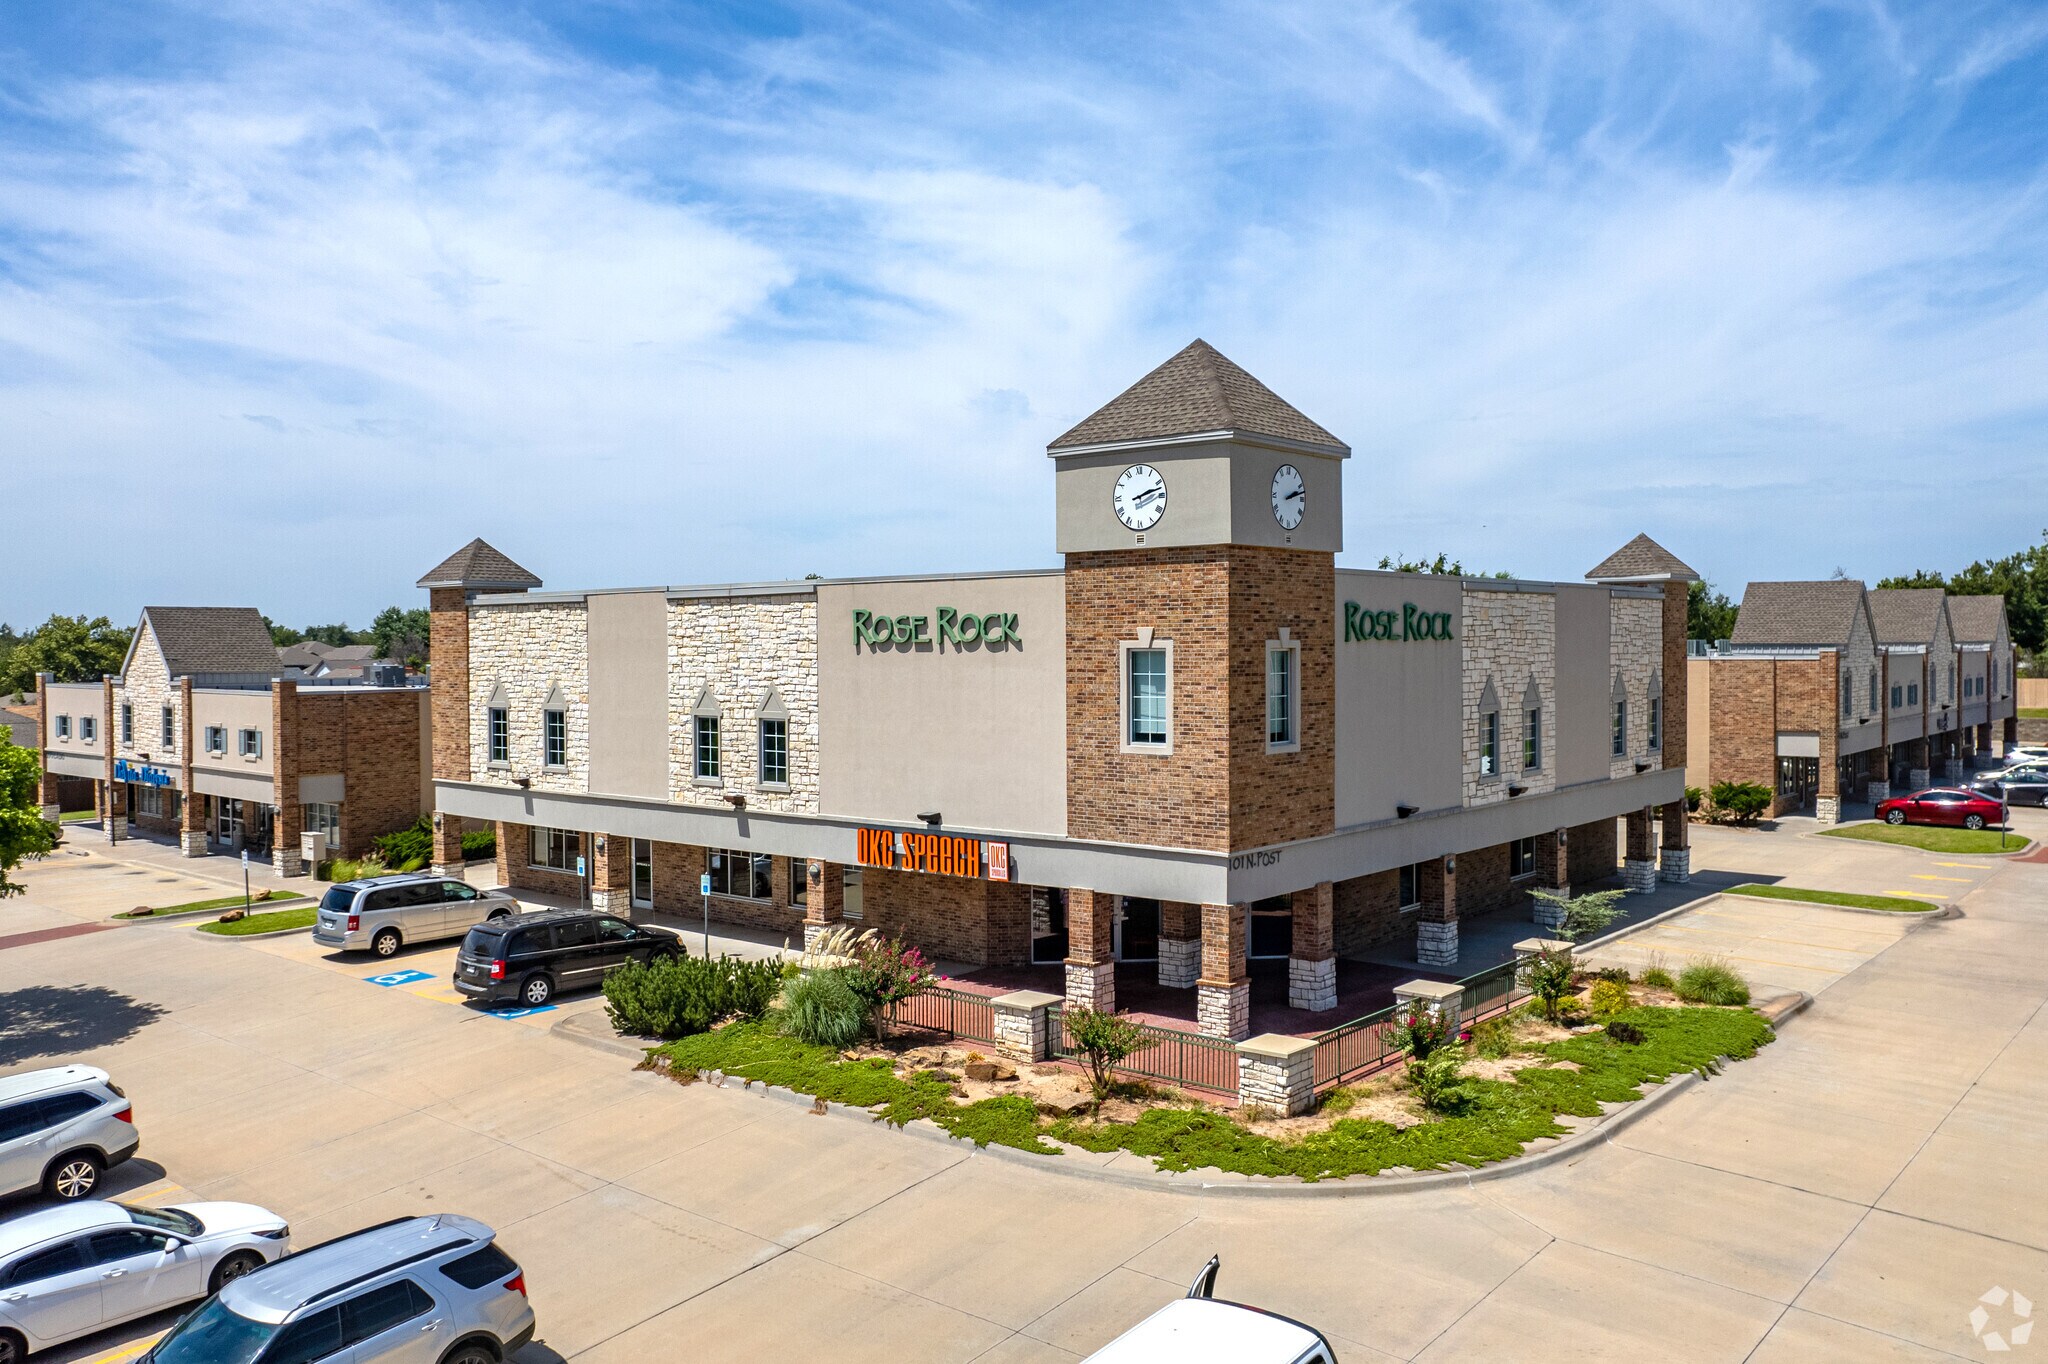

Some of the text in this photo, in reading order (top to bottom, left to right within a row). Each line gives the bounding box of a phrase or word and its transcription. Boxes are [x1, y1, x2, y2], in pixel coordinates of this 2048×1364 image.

[852, 606, 1022, 645] ROSE ROCK
[1344, 601, 1454, 642] ROSE ROCK
[857, 827, 895, 867] OKC
[991, 845, 1006, 869] OKC
